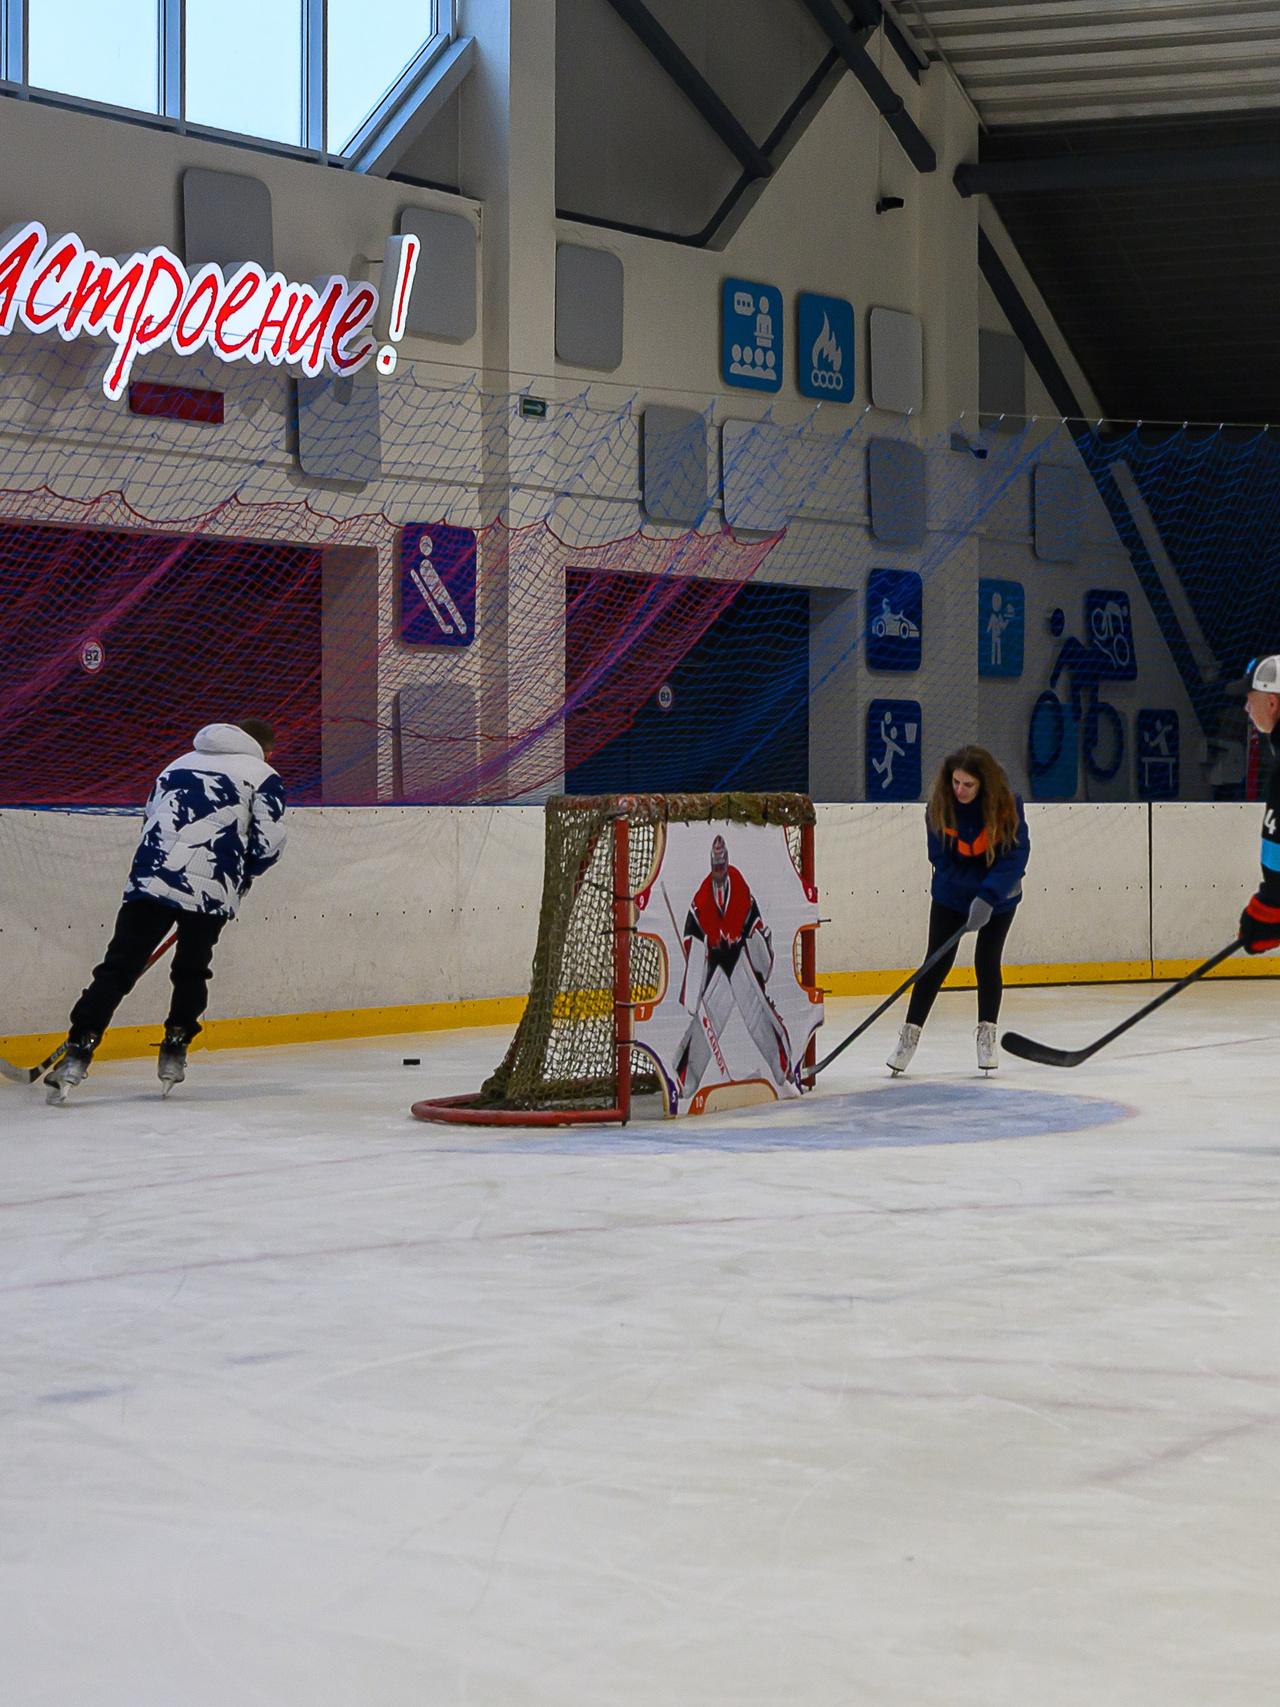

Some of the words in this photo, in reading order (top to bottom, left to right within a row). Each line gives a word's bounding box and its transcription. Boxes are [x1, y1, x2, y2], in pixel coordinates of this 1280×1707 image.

[1264, 808, 1277, 835] 4
[807, 887, 813, 899] 9
[639, 894, 645, 908] 9
[706, 1026, 726, 1076] CANADA
[671, 1090, 677, 1104] 5
[695, 1095, 704, 1109] 10
